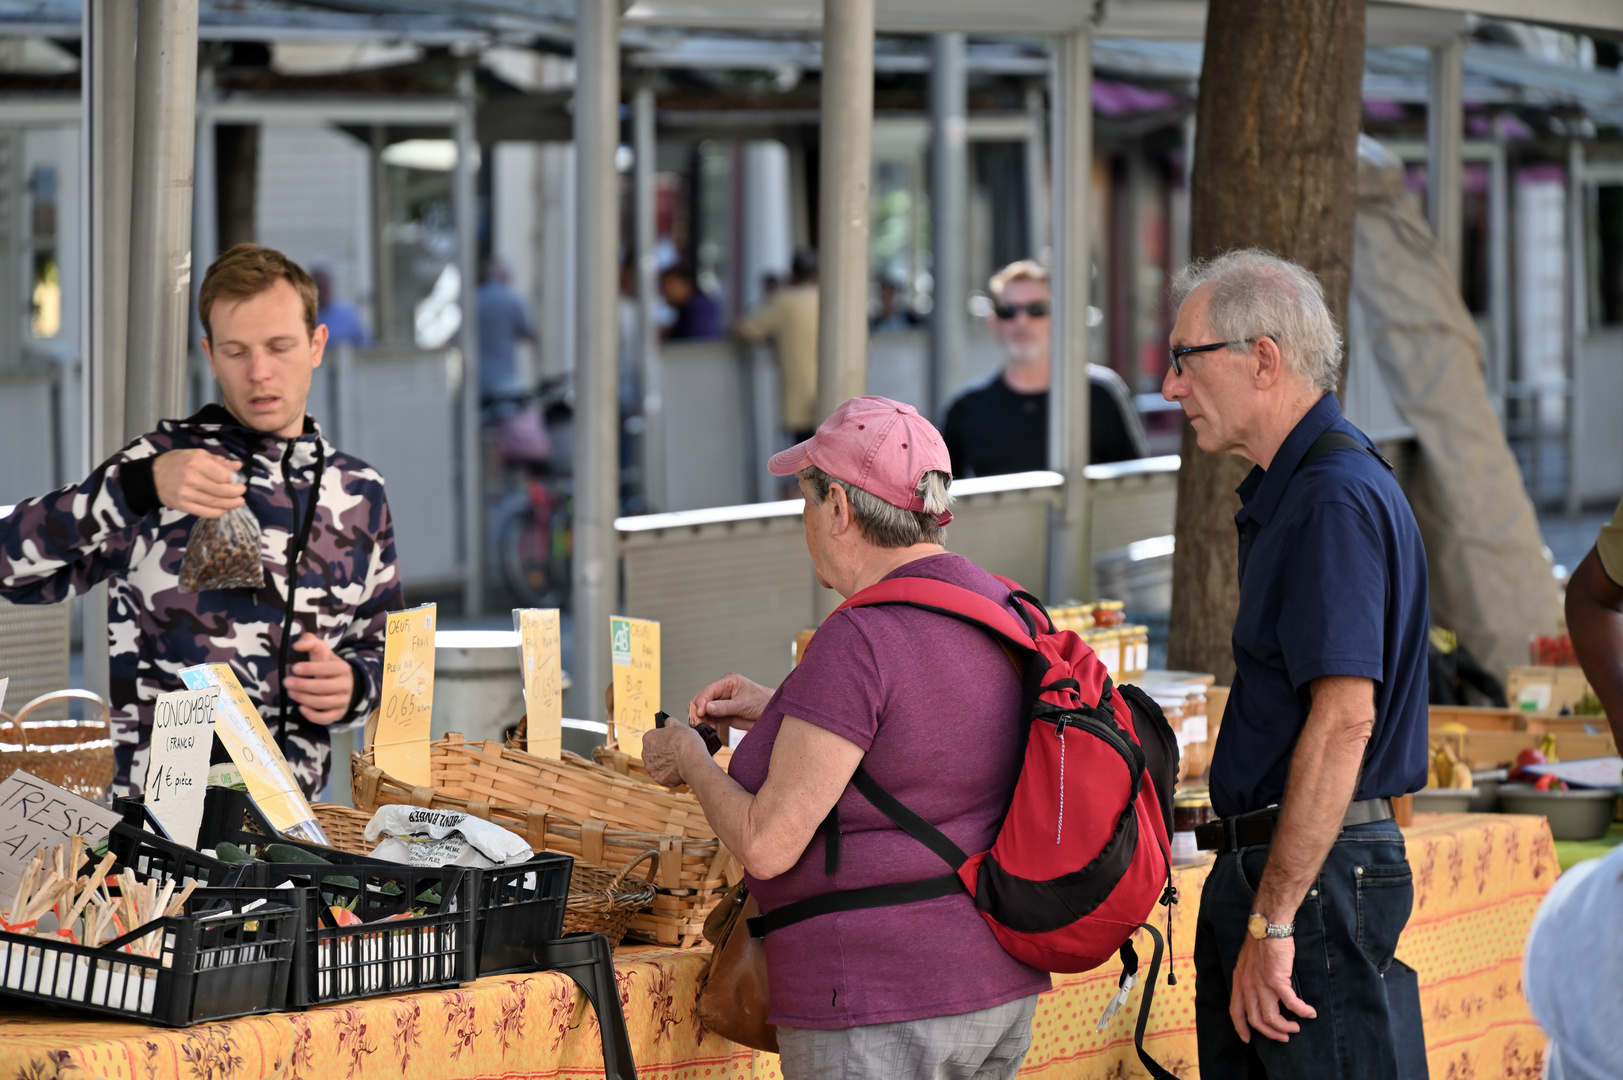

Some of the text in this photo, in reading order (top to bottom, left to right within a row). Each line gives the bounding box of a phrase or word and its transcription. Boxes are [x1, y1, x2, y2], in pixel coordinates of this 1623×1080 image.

[614, 629, 629, 652] AB
[157, 694, 218, 729] CONCOMBRE
[166, 736, 195, 752] (FRANCE)
[152, 764, 163, 802] 1
[165, 766, 173, 788] €
[174, 771, 193, 796] pièce
[1, 778, 108, 846] TRESSE
